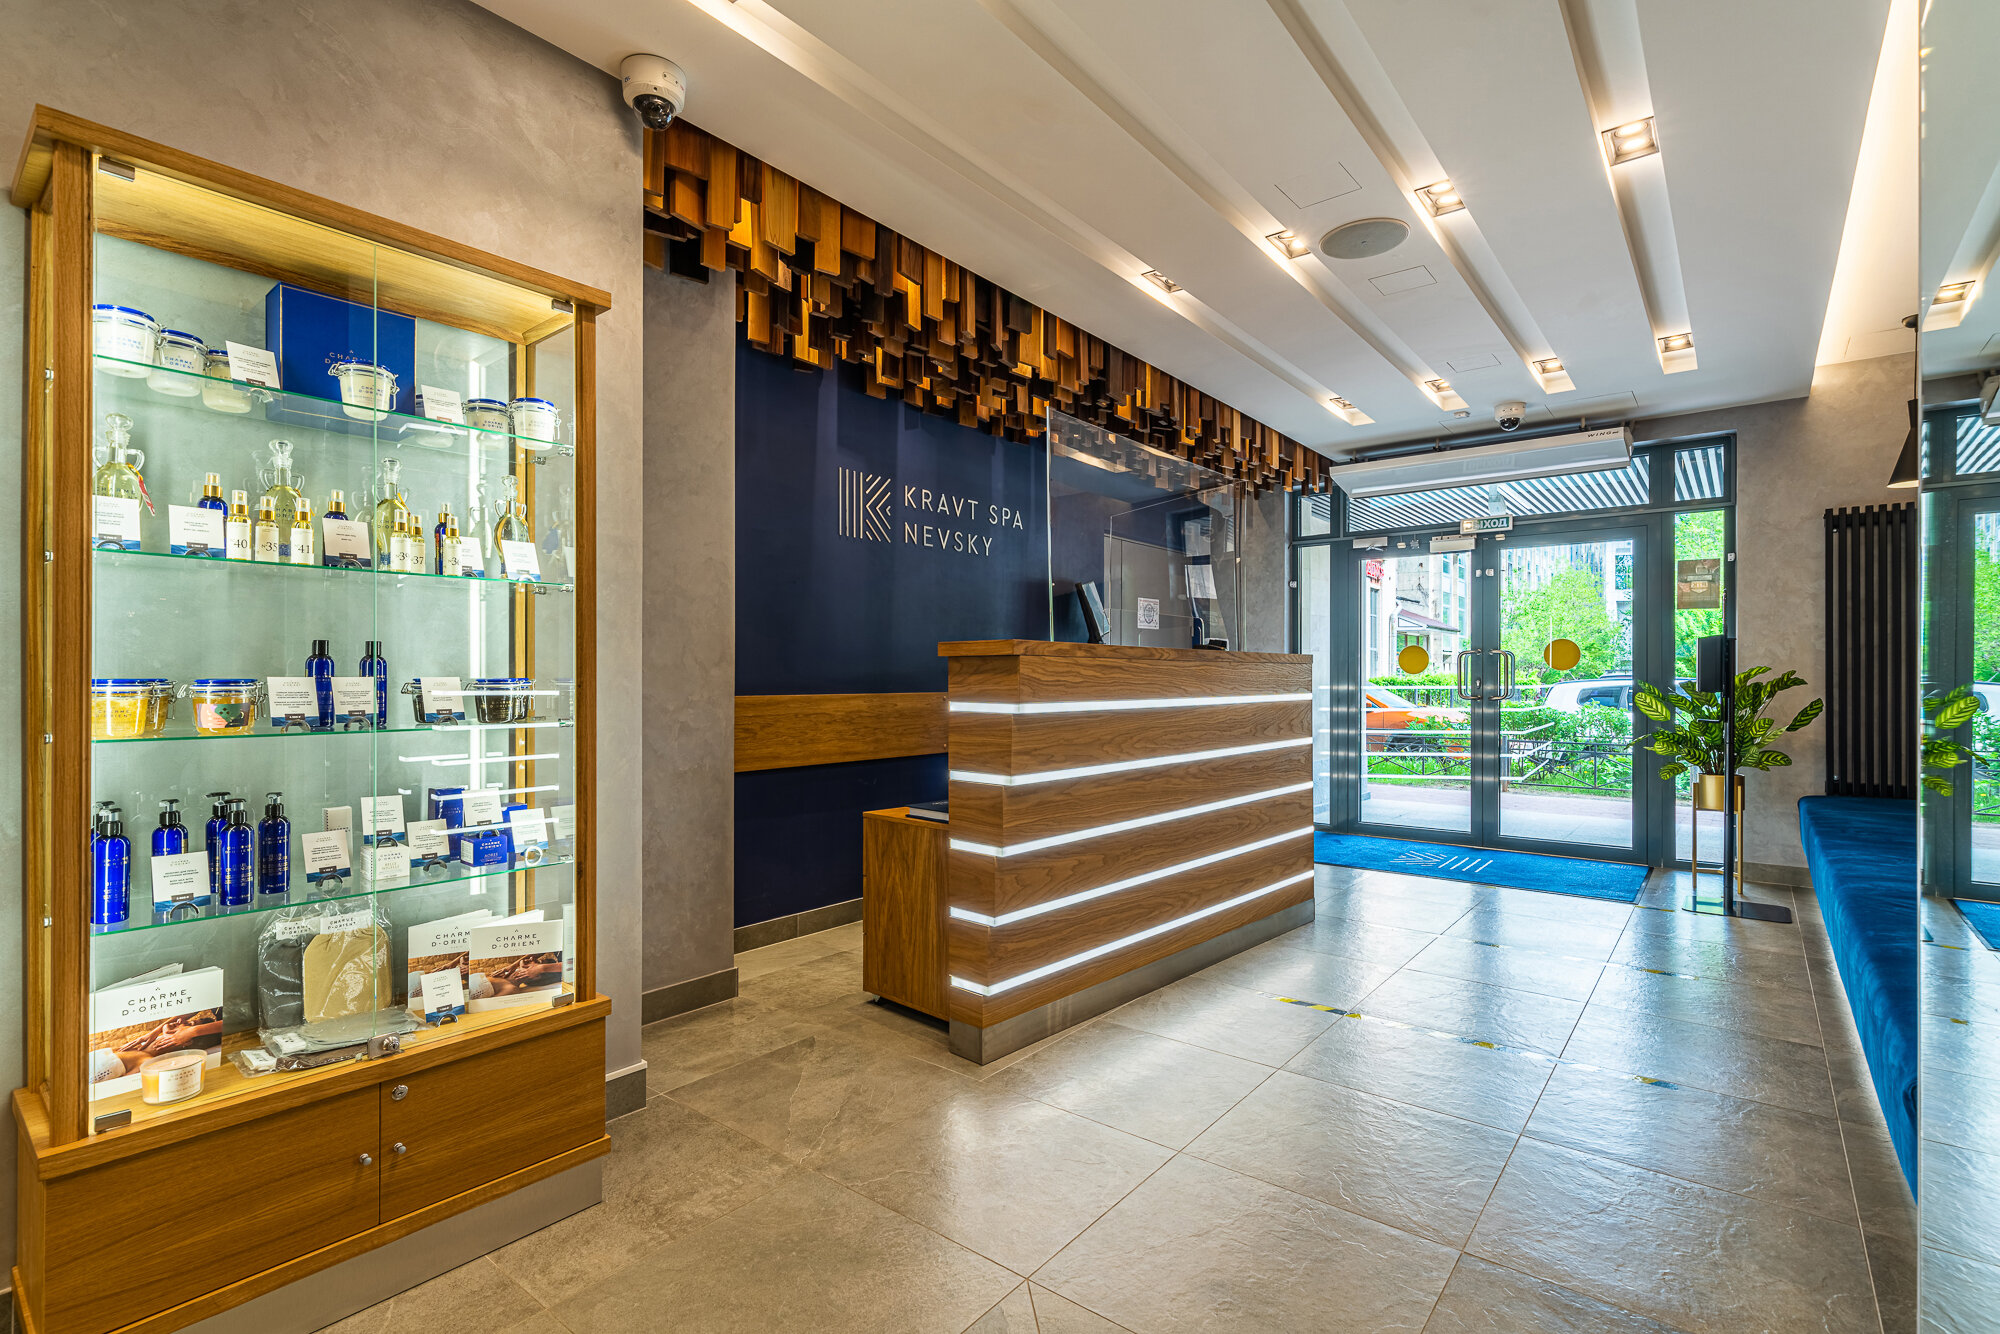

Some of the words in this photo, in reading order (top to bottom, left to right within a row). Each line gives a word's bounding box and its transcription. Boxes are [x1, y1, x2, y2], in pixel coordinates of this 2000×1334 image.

[904, 484, 979, 520] KRAVT
[988, 504, 1024, 531] SPA
[904, 521, 993, 557] NEVSKY
[431, 937, 468, 948] D·ORIE
[435, 931, 471, 940] CHARM
[495, 933, 538, 943] CHARME
[127, 989, 183, 1006] CHARME
